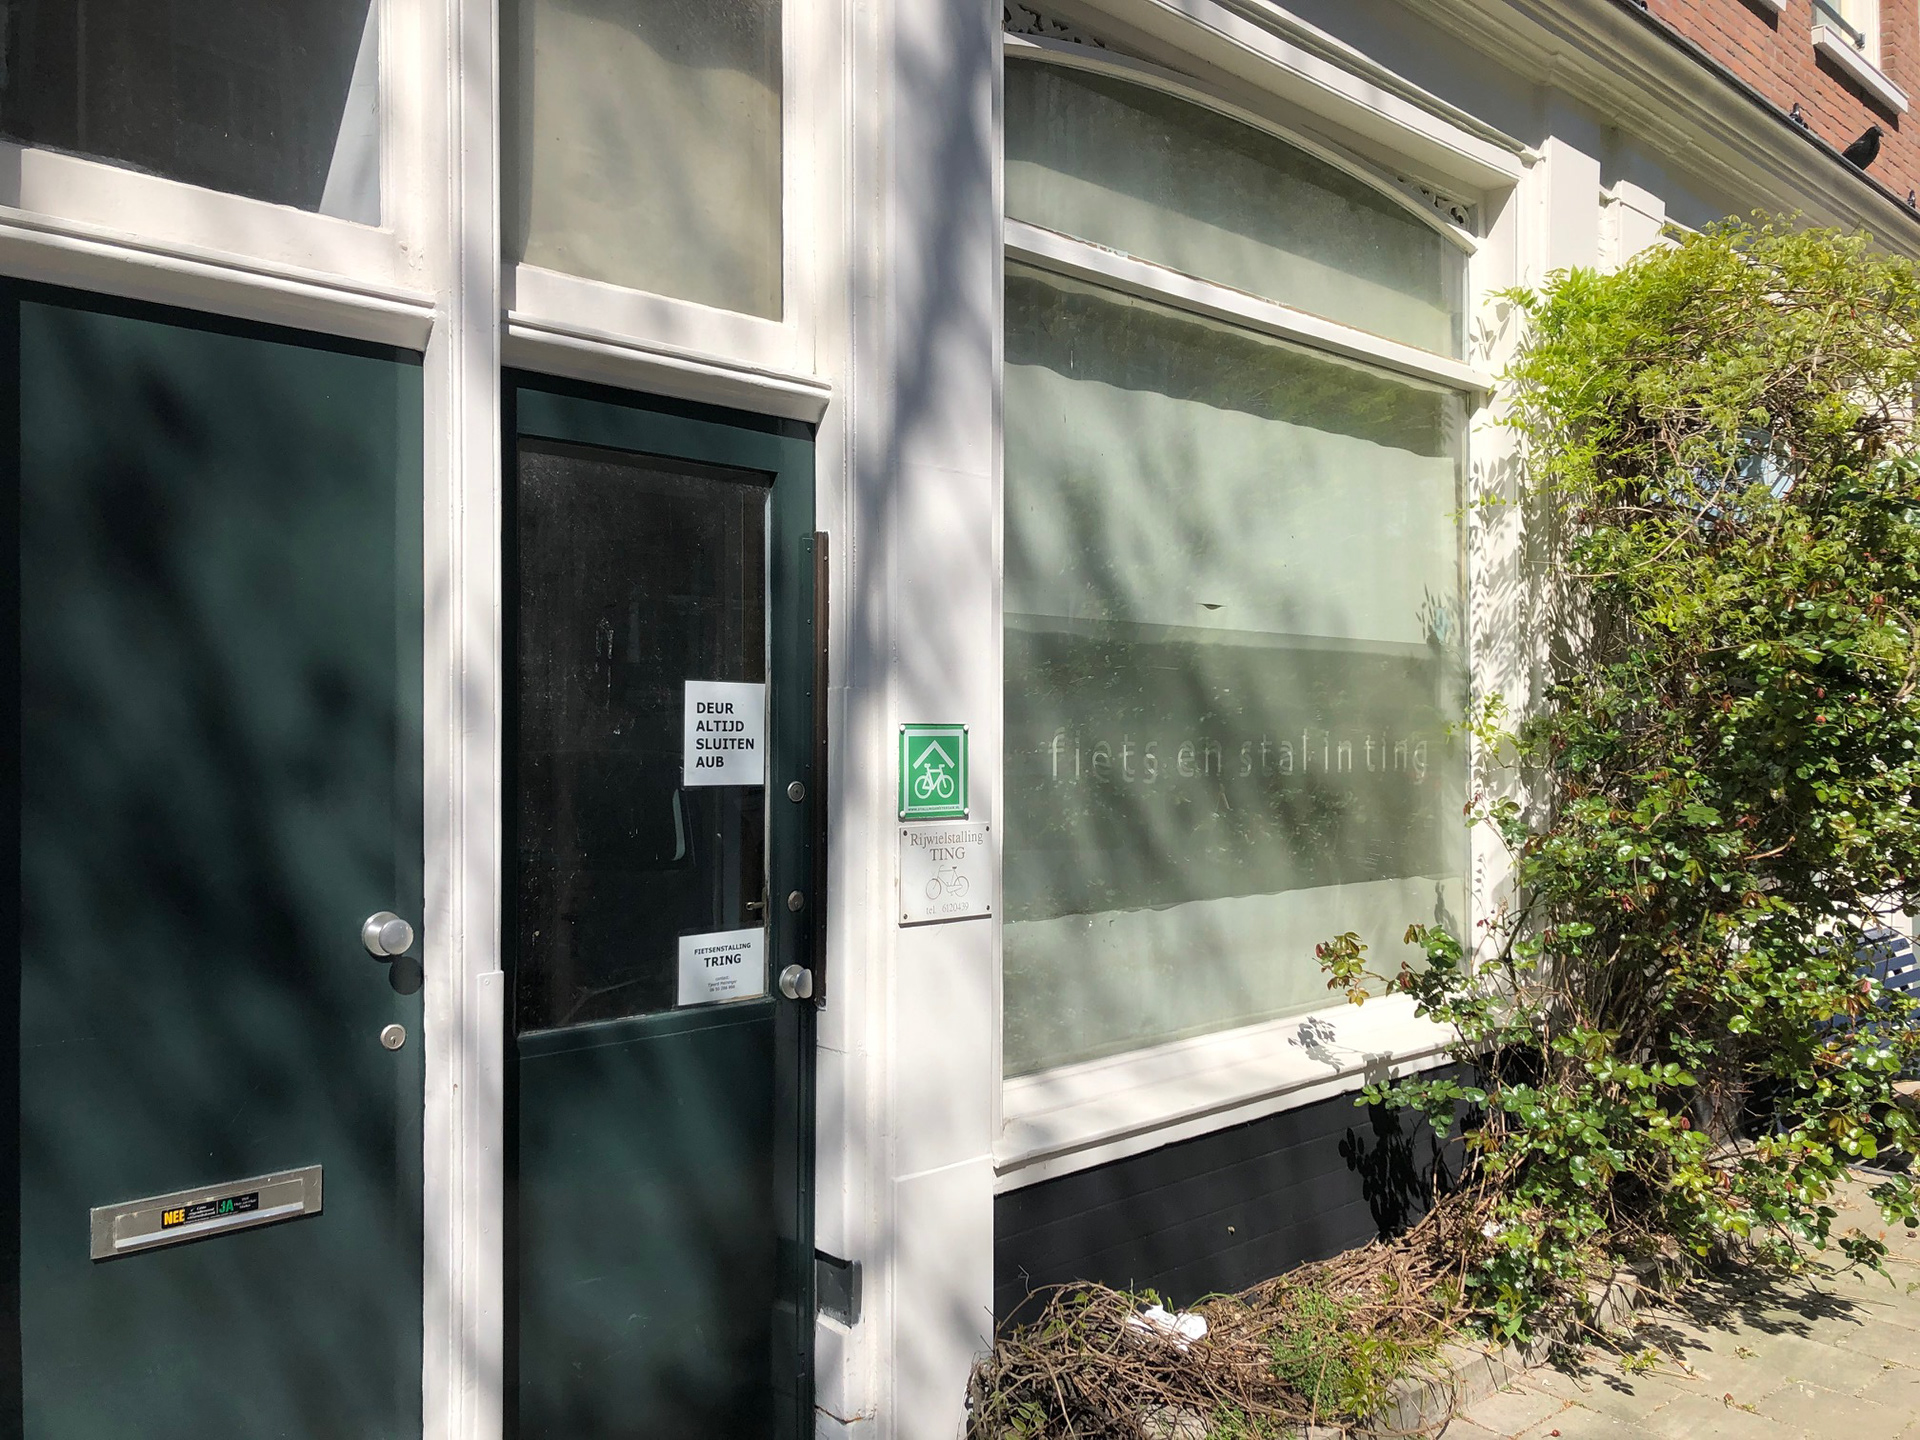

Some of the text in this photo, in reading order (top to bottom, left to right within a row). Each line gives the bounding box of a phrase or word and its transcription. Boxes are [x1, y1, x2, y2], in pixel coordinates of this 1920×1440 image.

[696, 702, 734, 714] DEUR
[696, 720, 745, 732] ALTIJD
[695, 738, 755, 750] SLUITEN
[695, 756, 725, 768] AUB
[1048, 727, 1158, 784] fiets
[910, 830, 984, 849] Rijwielstalling
[929, 847, 965, 861] TING
[694, 942, 752, 955] FIETSENSTALLING
[704, 953, 742, 968] TRING
[164, 1208, 186, 1226] NEE
[219, 1199, 234, 1214] JA
